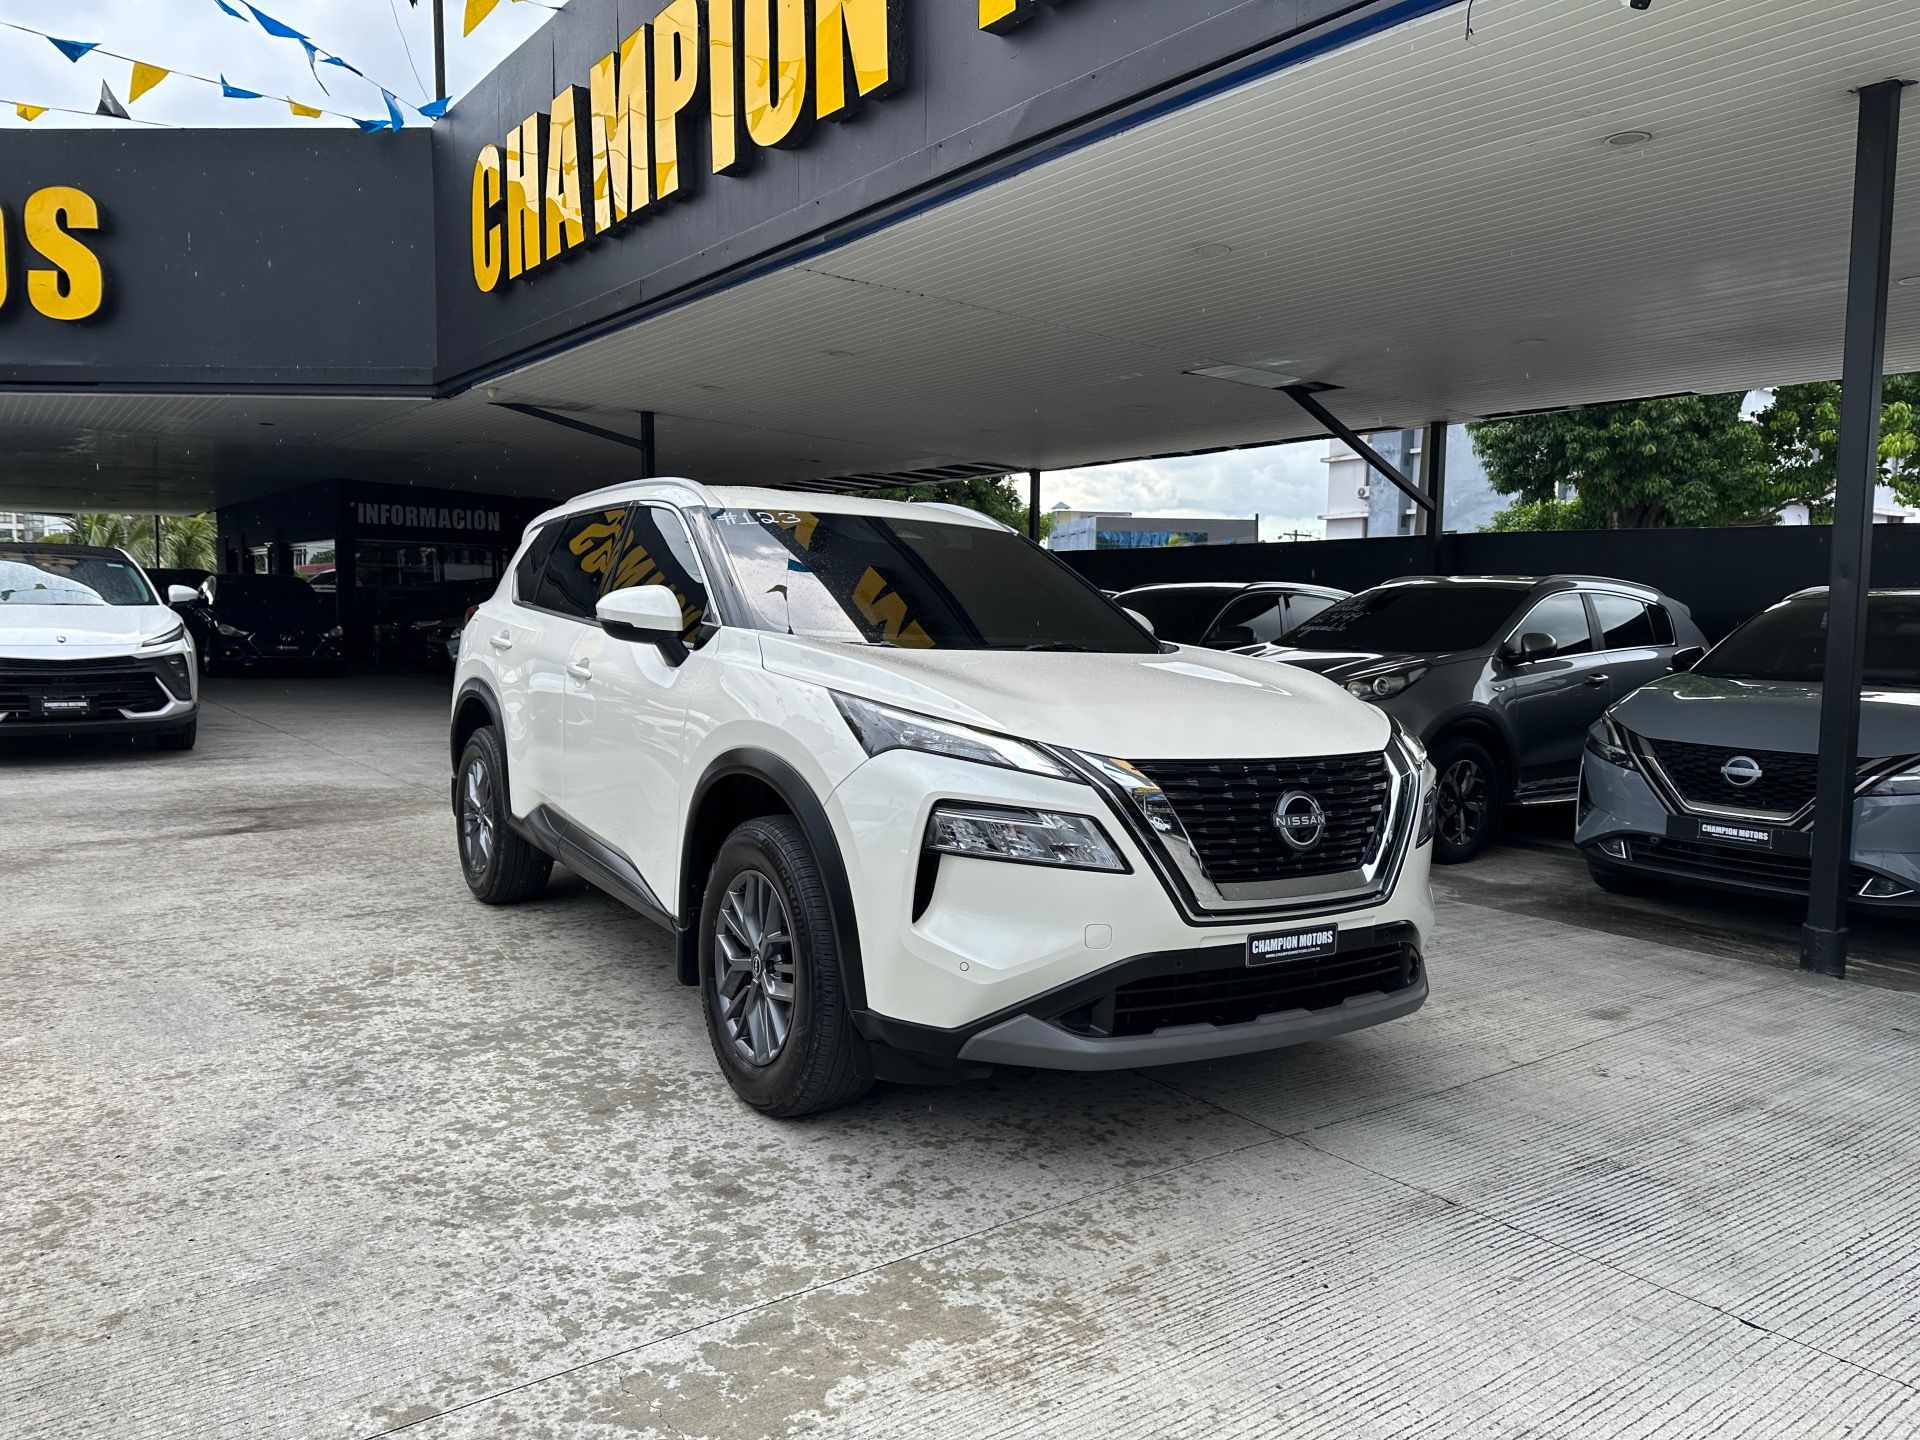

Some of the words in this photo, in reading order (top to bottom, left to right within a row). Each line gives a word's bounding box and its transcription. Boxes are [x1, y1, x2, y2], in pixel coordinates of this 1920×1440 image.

[0, 186, 102, 320] S
[716, 512, 801, 526] #123
[1276, 815, 1323, 826] NISSAN
[1702, 824, 1737, 836] CHAMPION
[1738, 829, 1768, 841] MOTORS
[1252, 935, 1298, 954] CHAMPION
[1299, 930, 1333, 948] MOTORS
